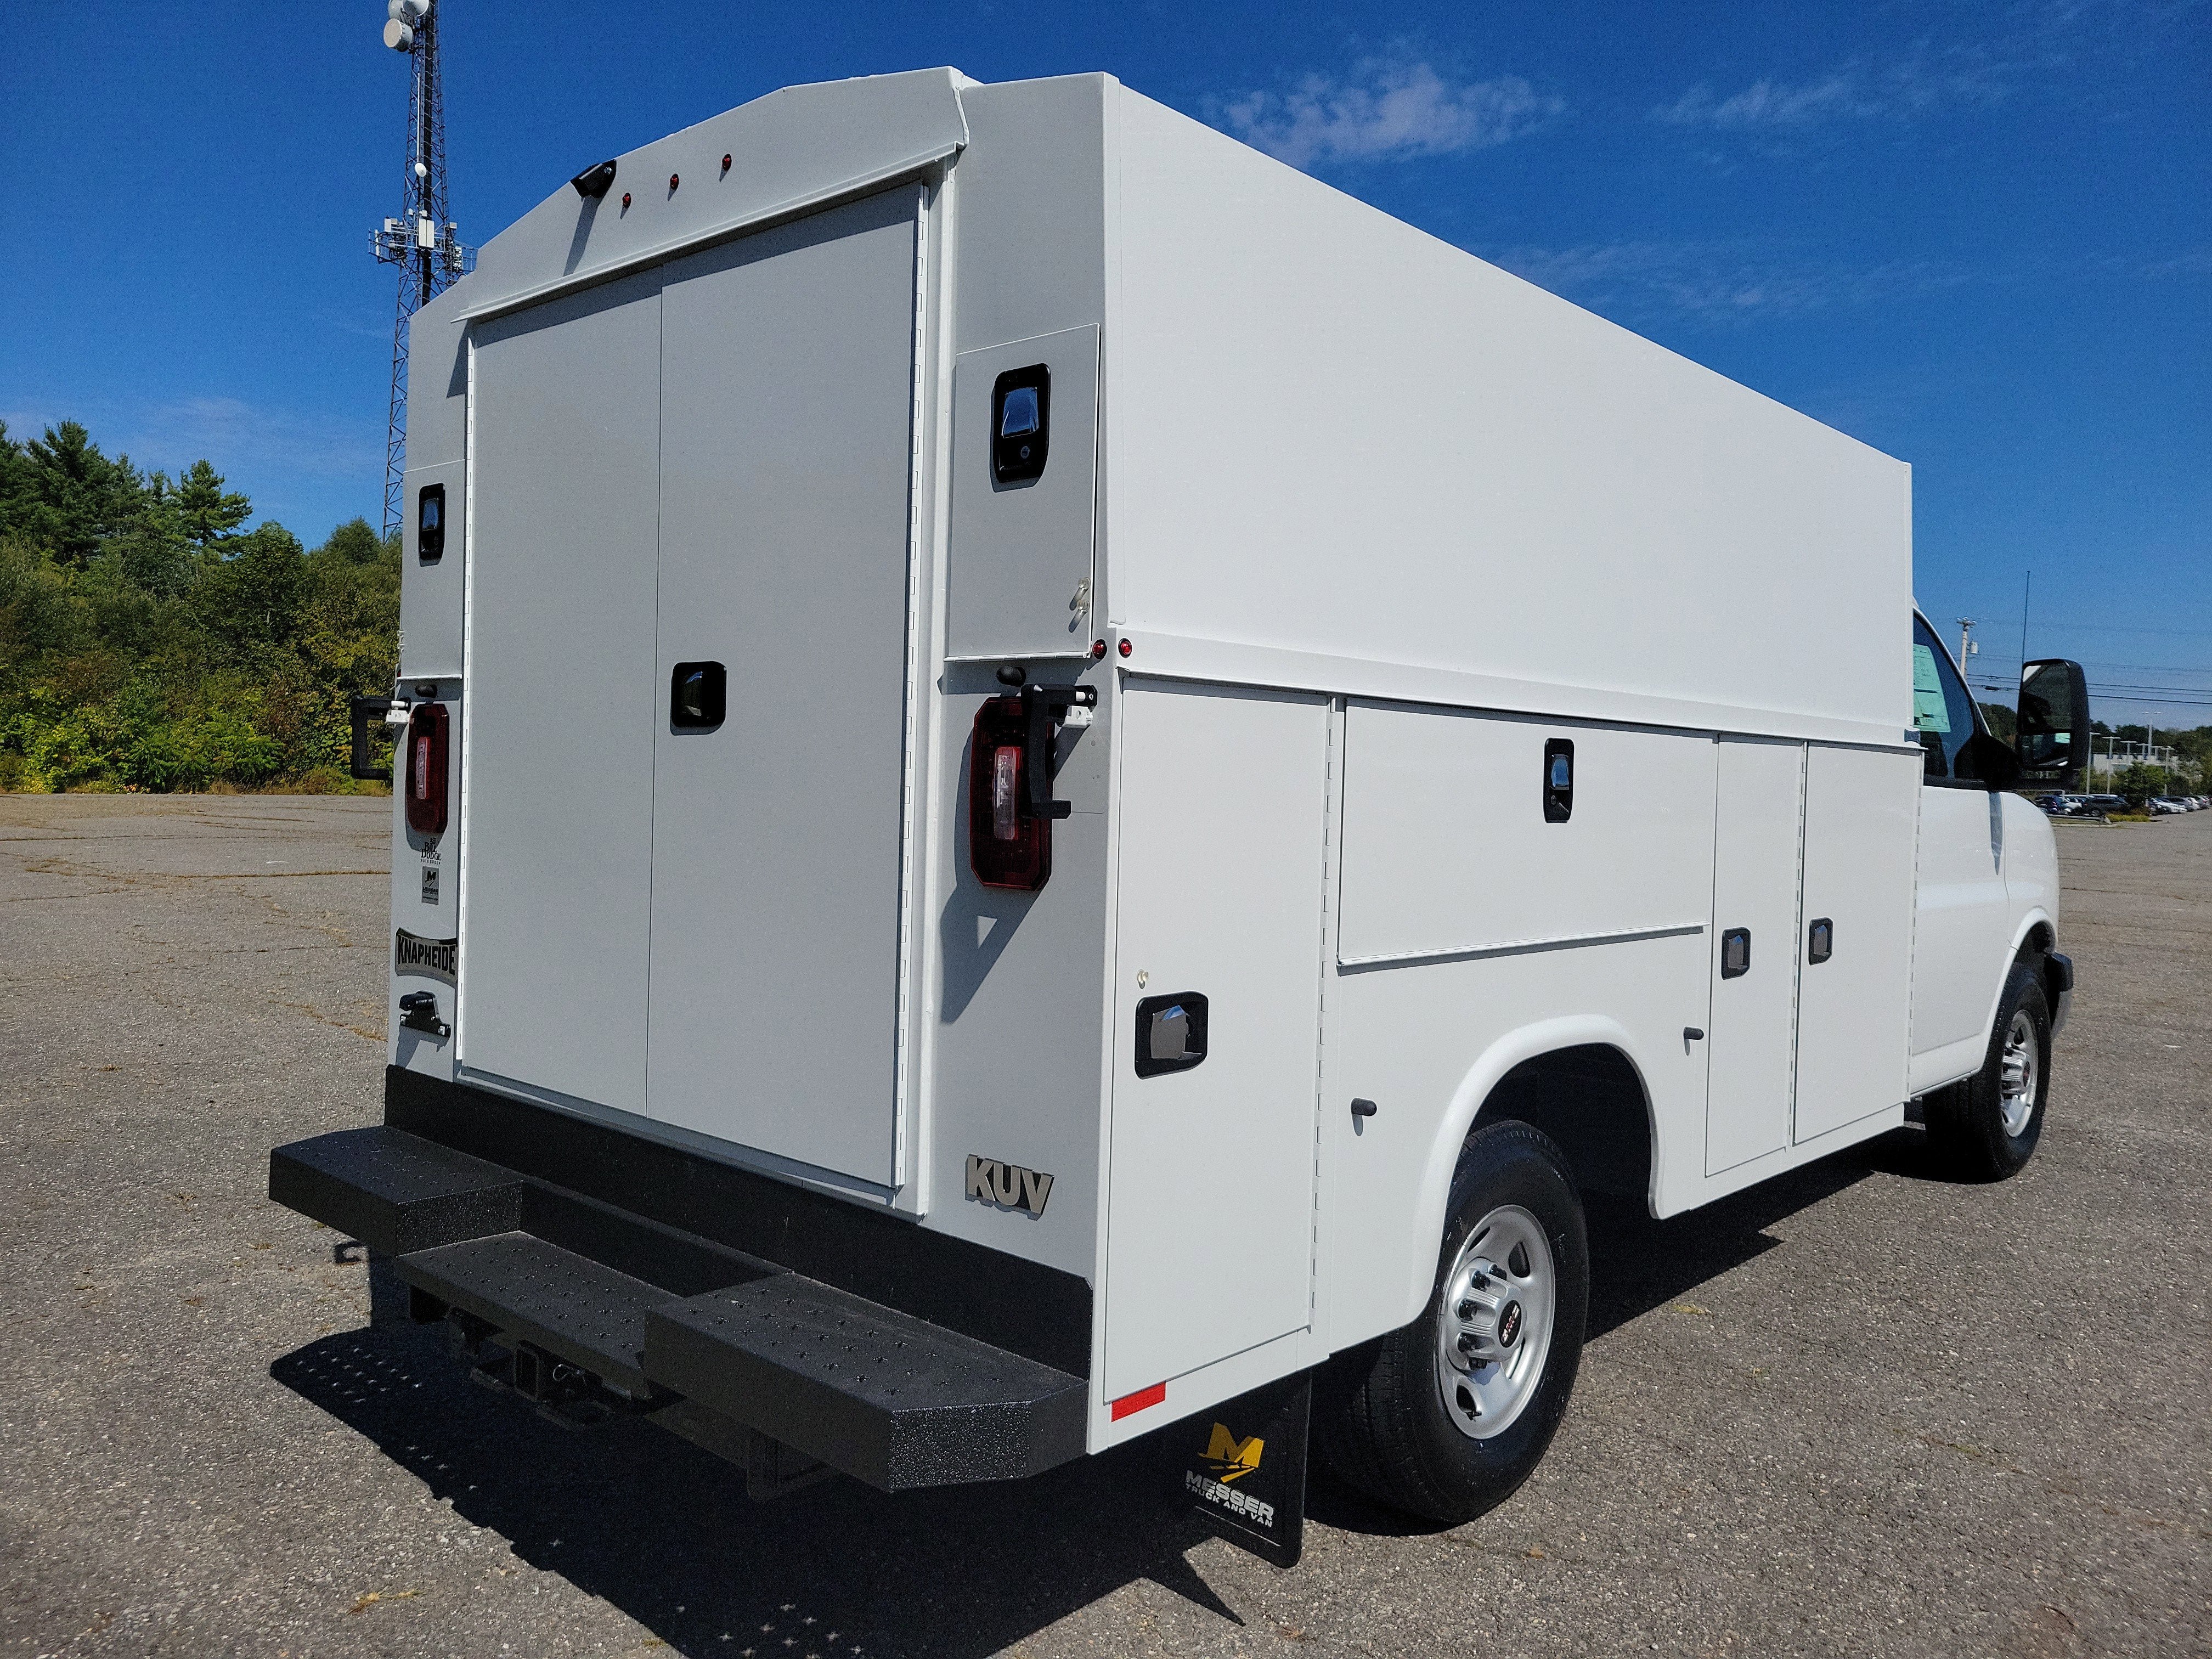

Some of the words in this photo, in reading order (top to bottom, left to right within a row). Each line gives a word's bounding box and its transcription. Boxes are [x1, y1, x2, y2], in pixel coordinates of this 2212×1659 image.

[421, 849, 442, 861] DODGE
[398, 935, 456, 976] KNAPHEIDE
[966, 1154, 1054, 1218] KUV
[1186, 1470, 1274, 1521] MESSER
[1186, 1483, 1220, 1503] TRUCK
[1223, 1501, 1246, 1515] AND
[1250, 1513, 1273, 1528] VAN
